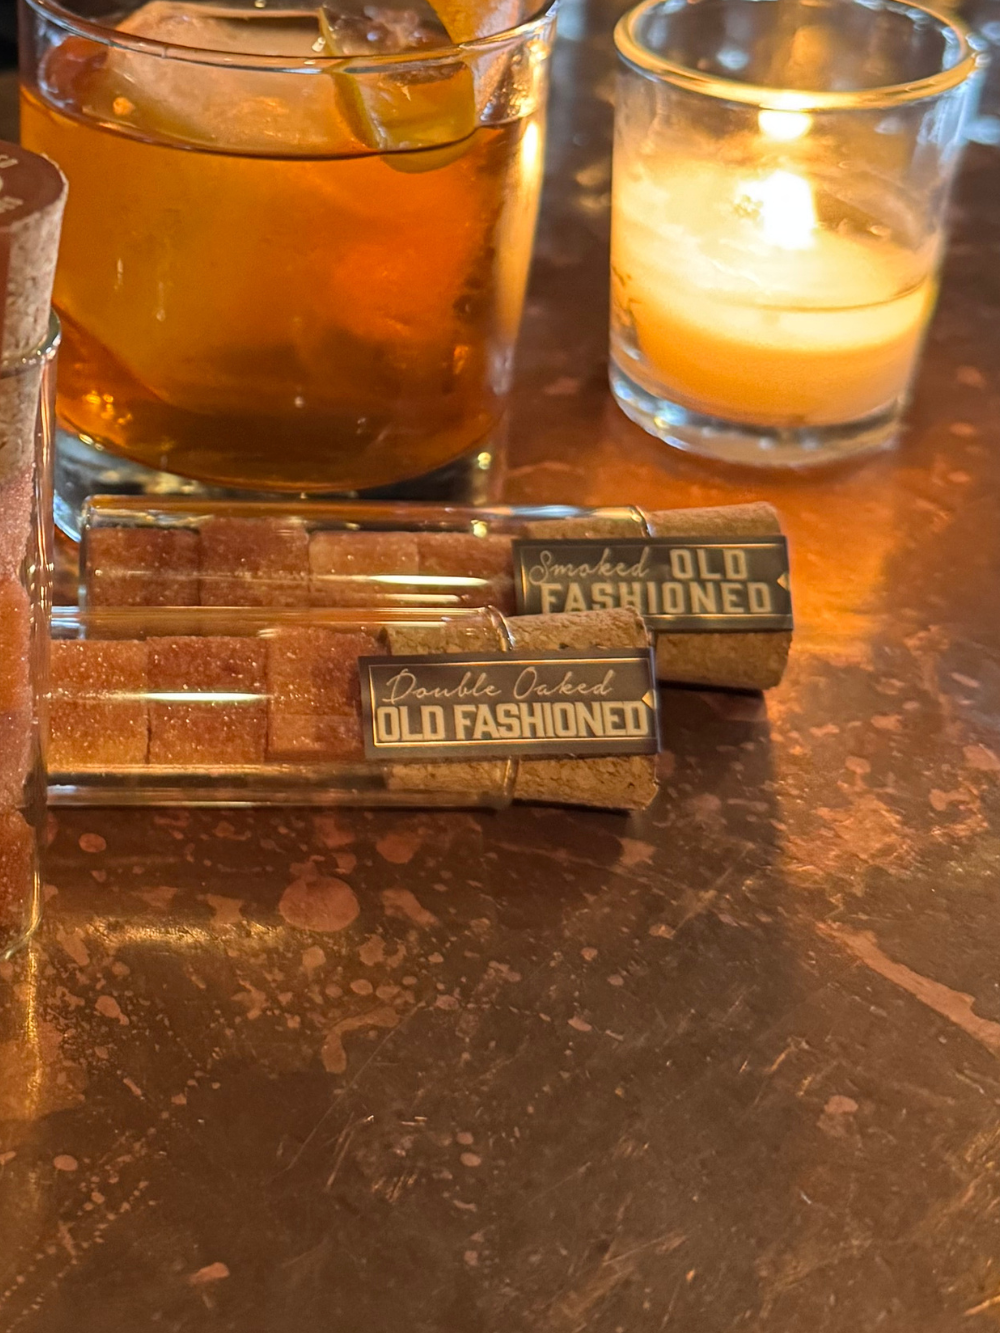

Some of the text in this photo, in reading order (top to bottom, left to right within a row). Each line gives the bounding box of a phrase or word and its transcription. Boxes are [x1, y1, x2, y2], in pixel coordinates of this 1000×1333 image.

[528, 546, 749, 586] Smoked OLD
[540, 581, 775, 614] FASHIONED
[382, 666, 614, 704] Double Oaked
[376, 700, 650, 742] OLD FASHIONED
